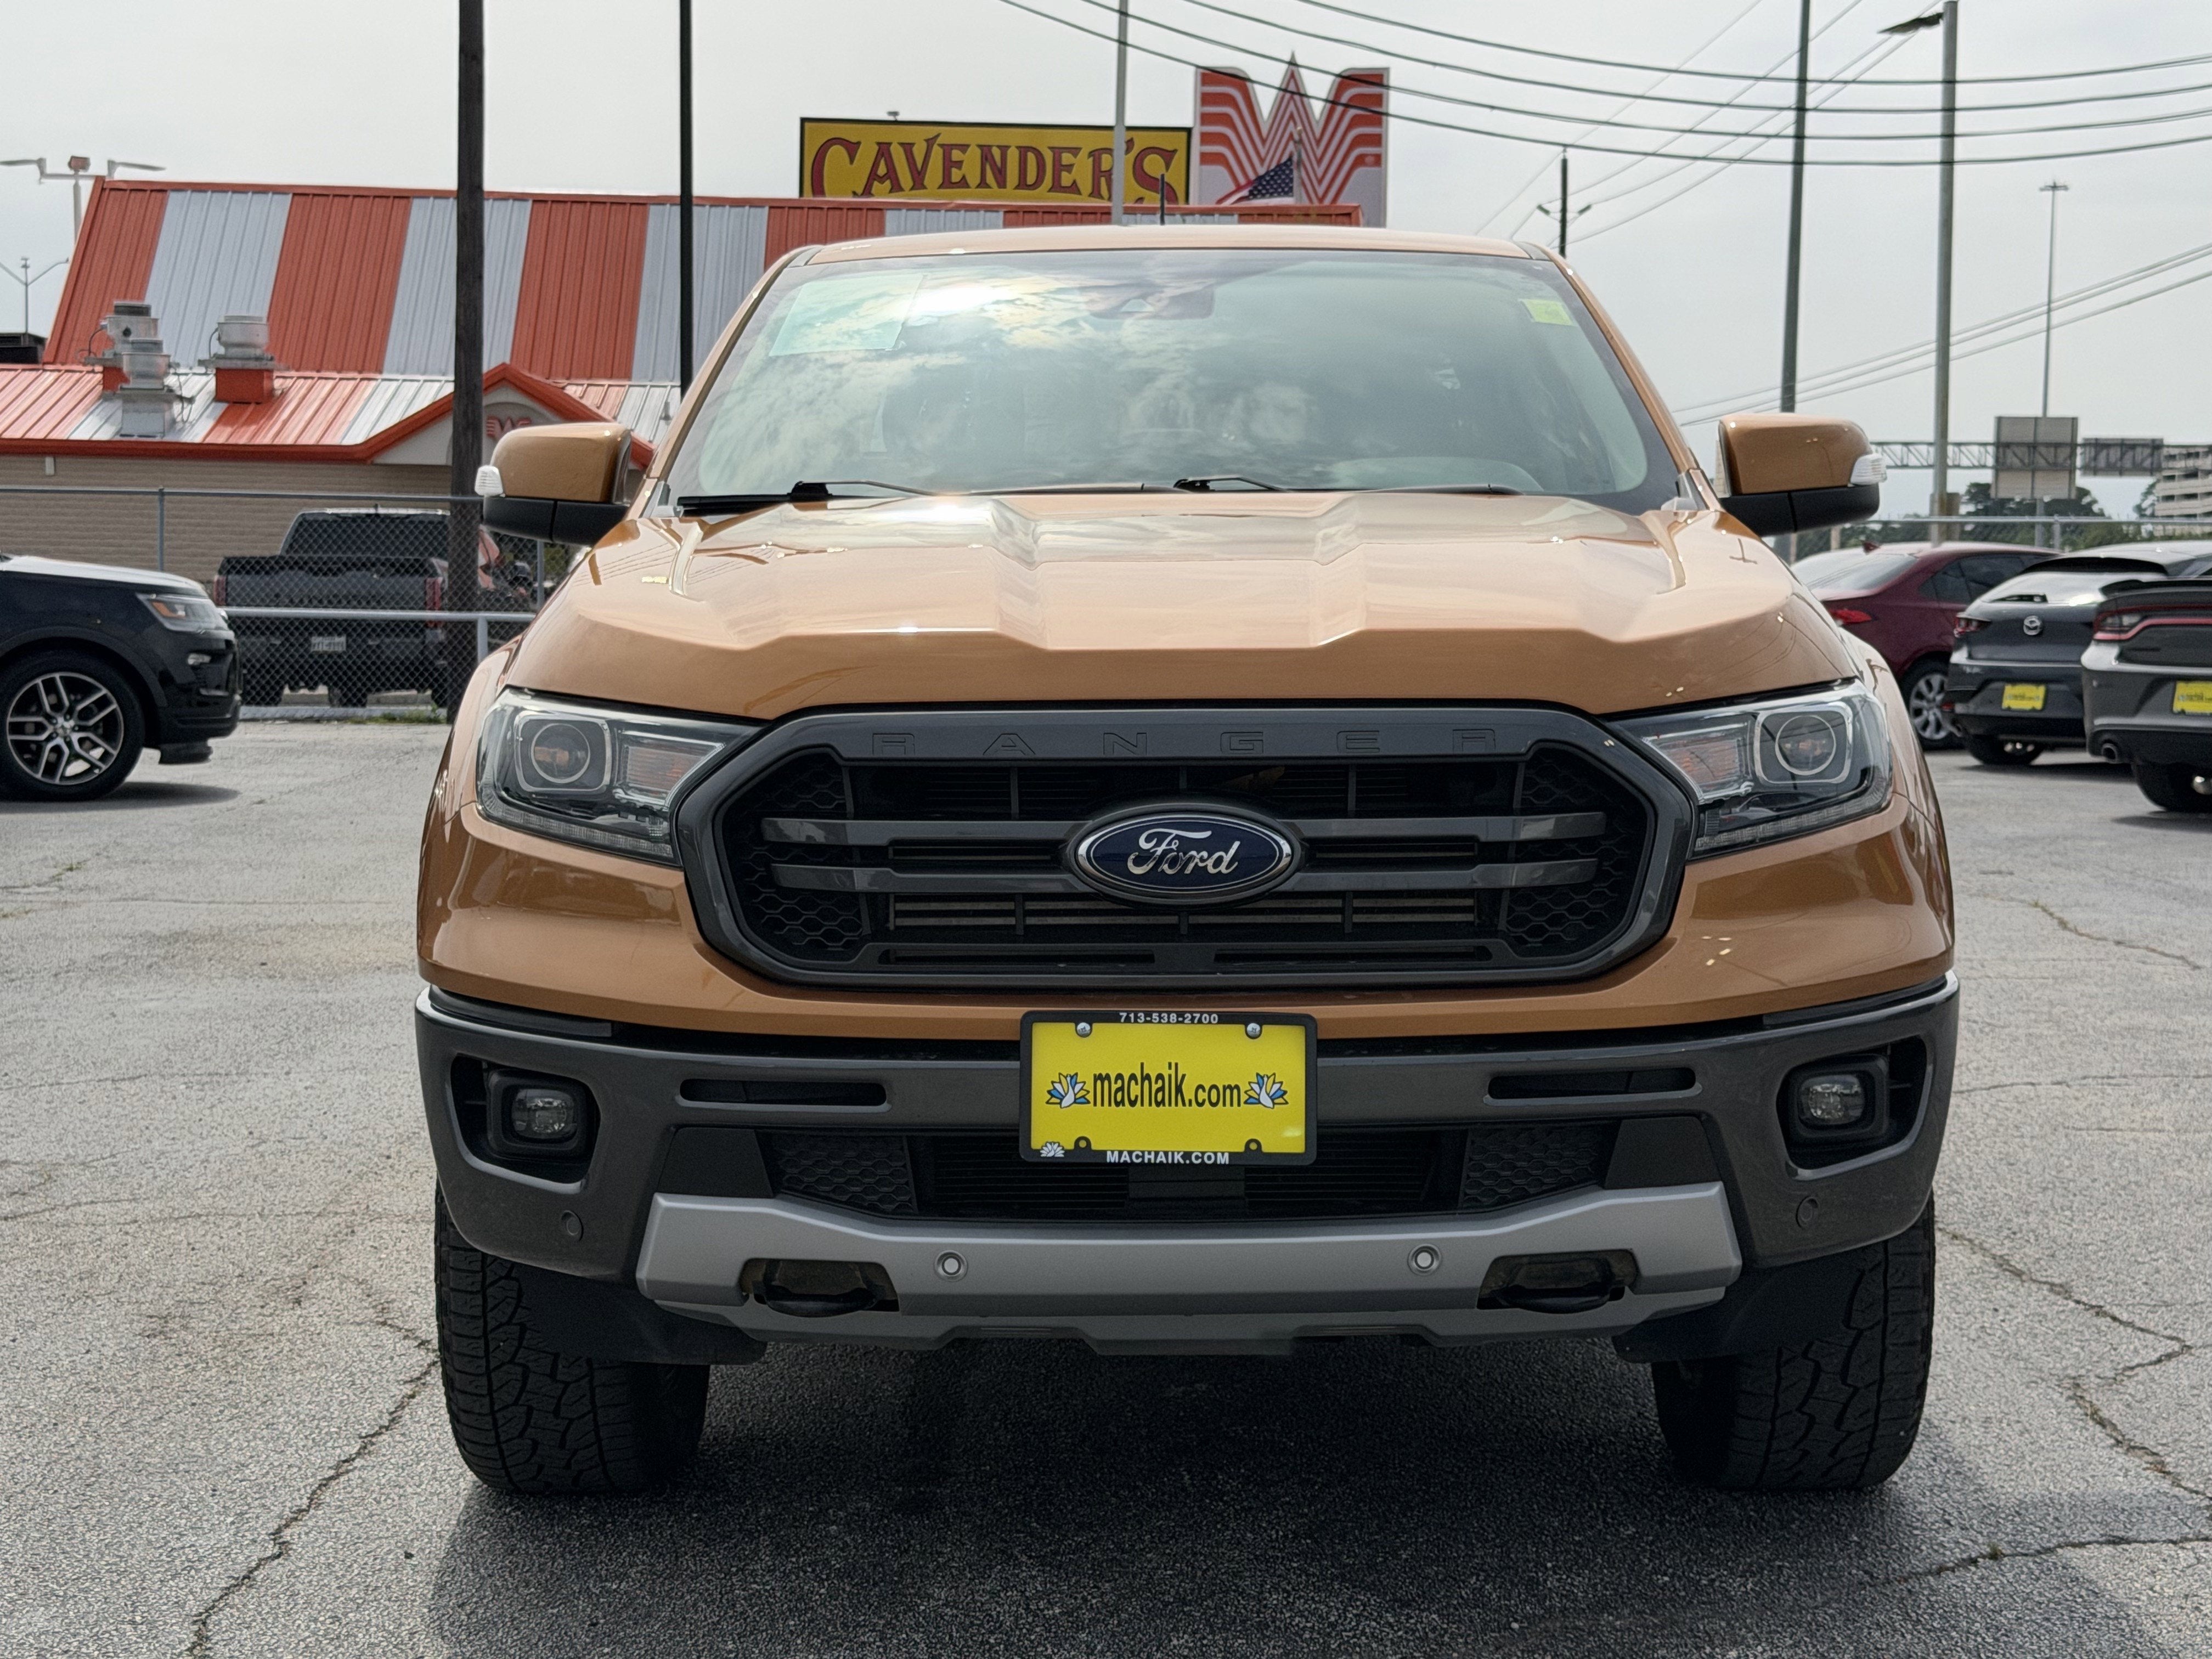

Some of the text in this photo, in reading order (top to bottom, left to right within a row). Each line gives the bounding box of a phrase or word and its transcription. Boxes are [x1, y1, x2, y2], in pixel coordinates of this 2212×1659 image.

[811, 132, 1179, 204] CAVENDER'S
[872, 729, 1496, 755] RANGER
[1127, 828, 1240, 874] Ford
[1119, 1013, 1218, 1024] 713-538-2700
[1092, 1062, 1241, 1108] machaik.com
[1106, 1151, 1229, 1165] MACHAIK.COM
